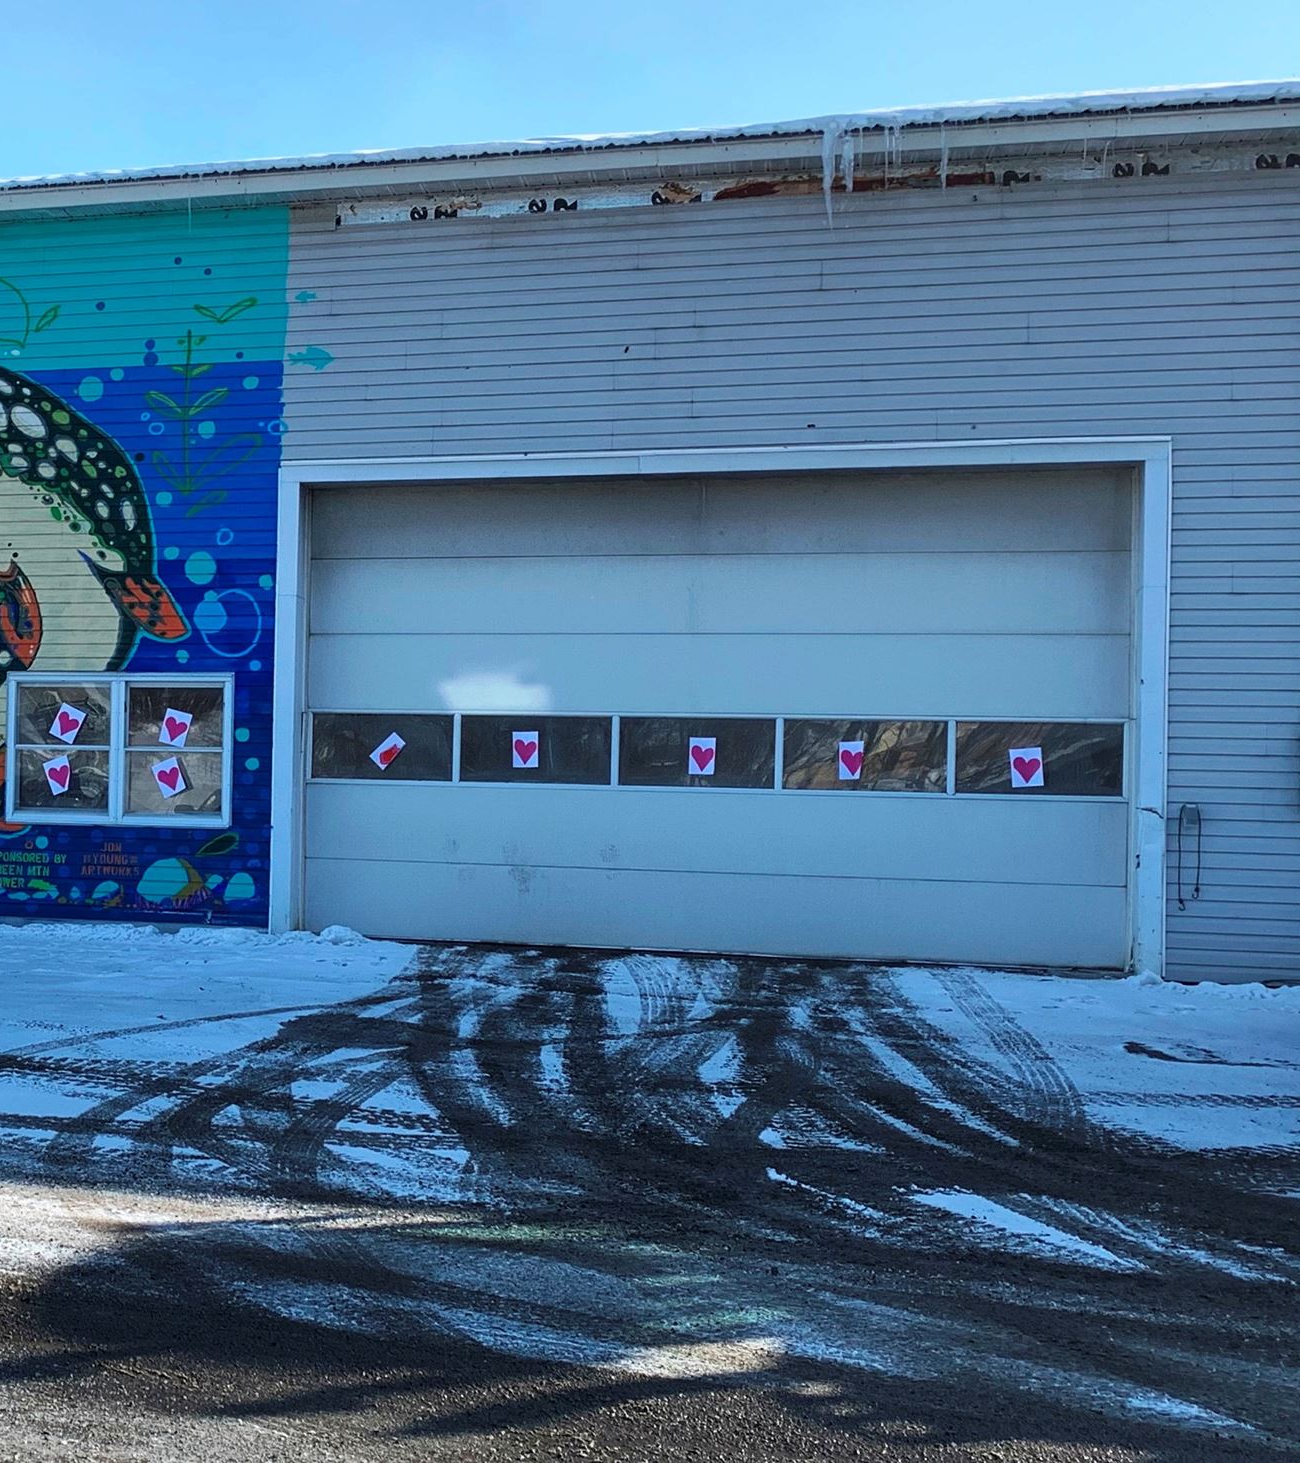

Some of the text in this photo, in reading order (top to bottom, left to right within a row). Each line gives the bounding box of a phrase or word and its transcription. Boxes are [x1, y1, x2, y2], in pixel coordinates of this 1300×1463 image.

[100, 841, 122, 853] JON
[54, 853, 67, 864] BY
[92, 853, 128, 865] YOUNG
[27, 866, 50, 877] MTN
[80, 865, 140, 877] ARTWORKS
